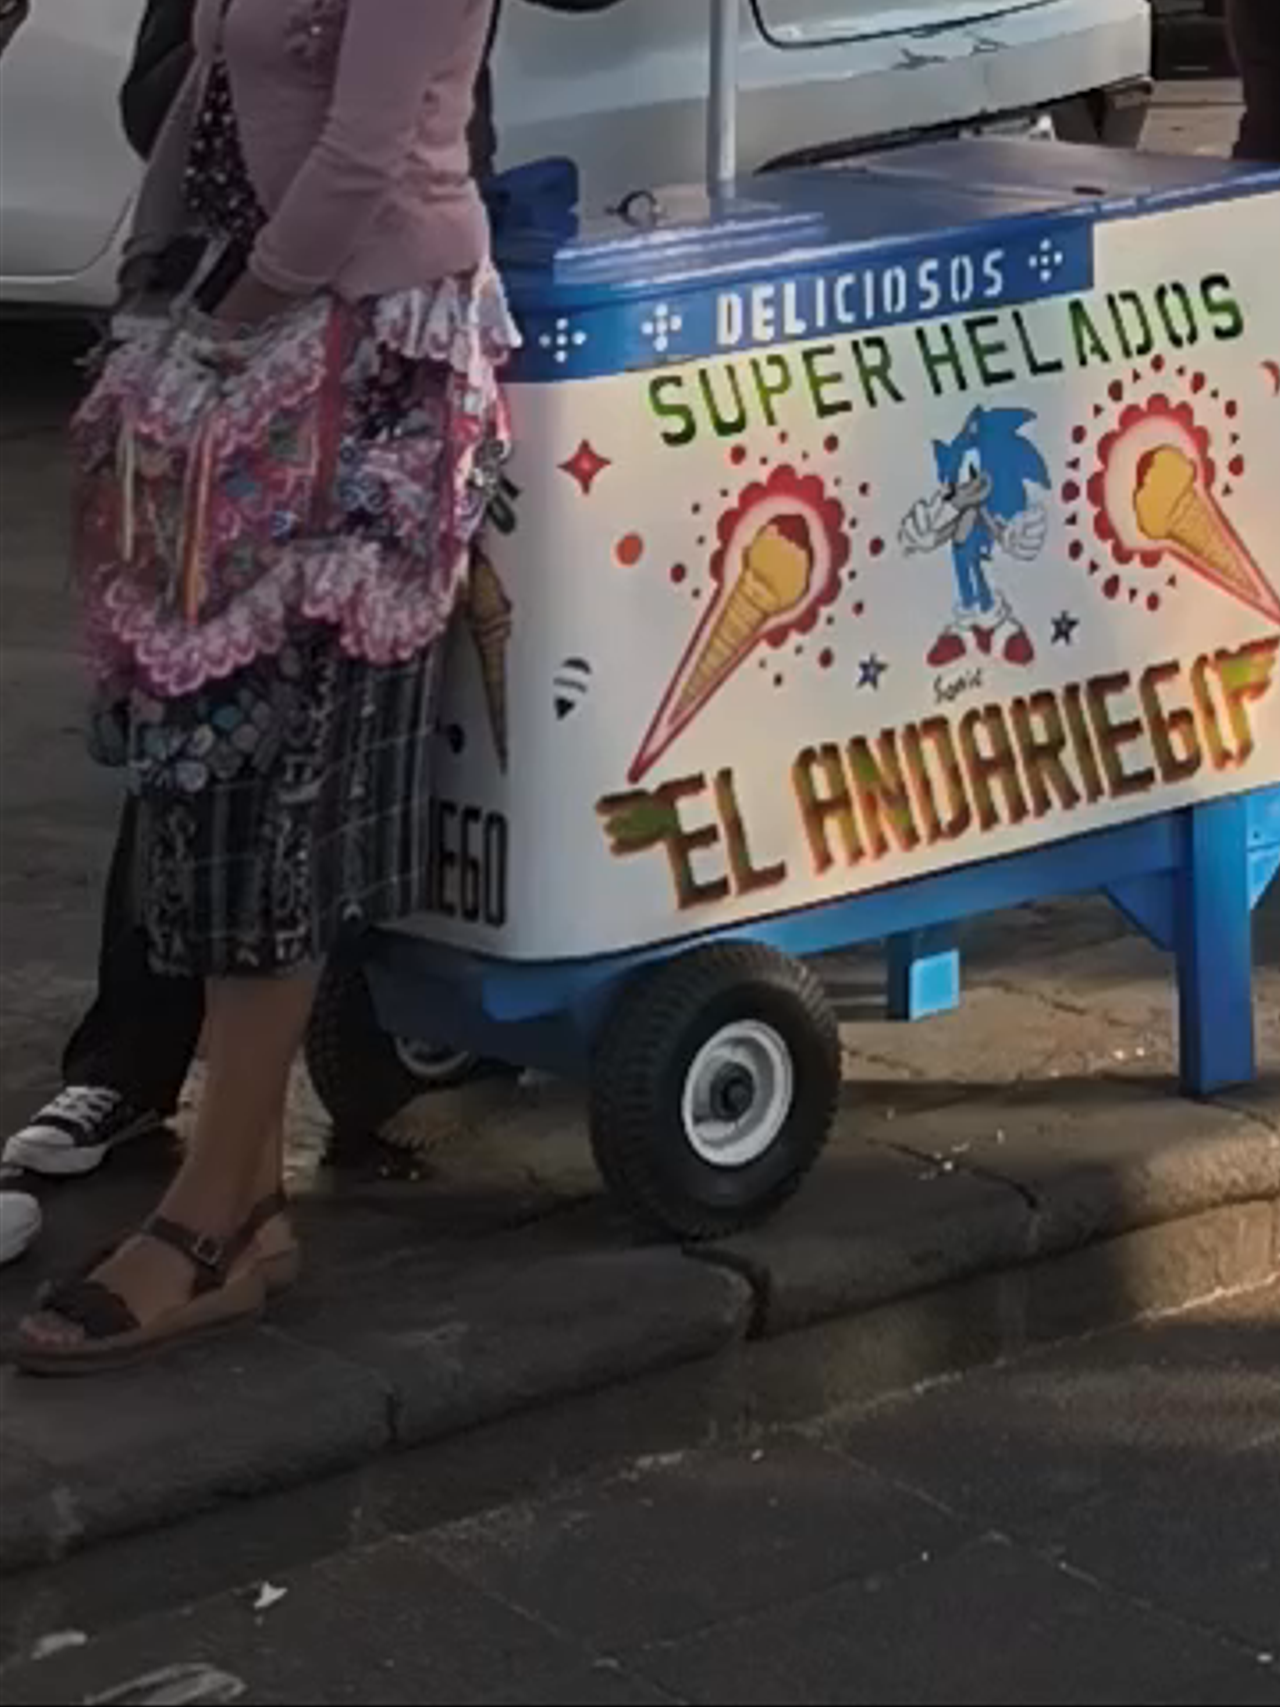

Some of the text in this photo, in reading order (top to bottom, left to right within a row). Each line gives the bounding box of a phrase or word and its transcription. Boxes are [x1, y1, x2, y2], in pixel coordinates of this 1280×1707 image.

[647, 274, 1245, 447] SUPER HELADOS
[716, 248, 1006, 345] DELICIOSOS
[660, 640, 1270, 911] EL ANDARIEGO
